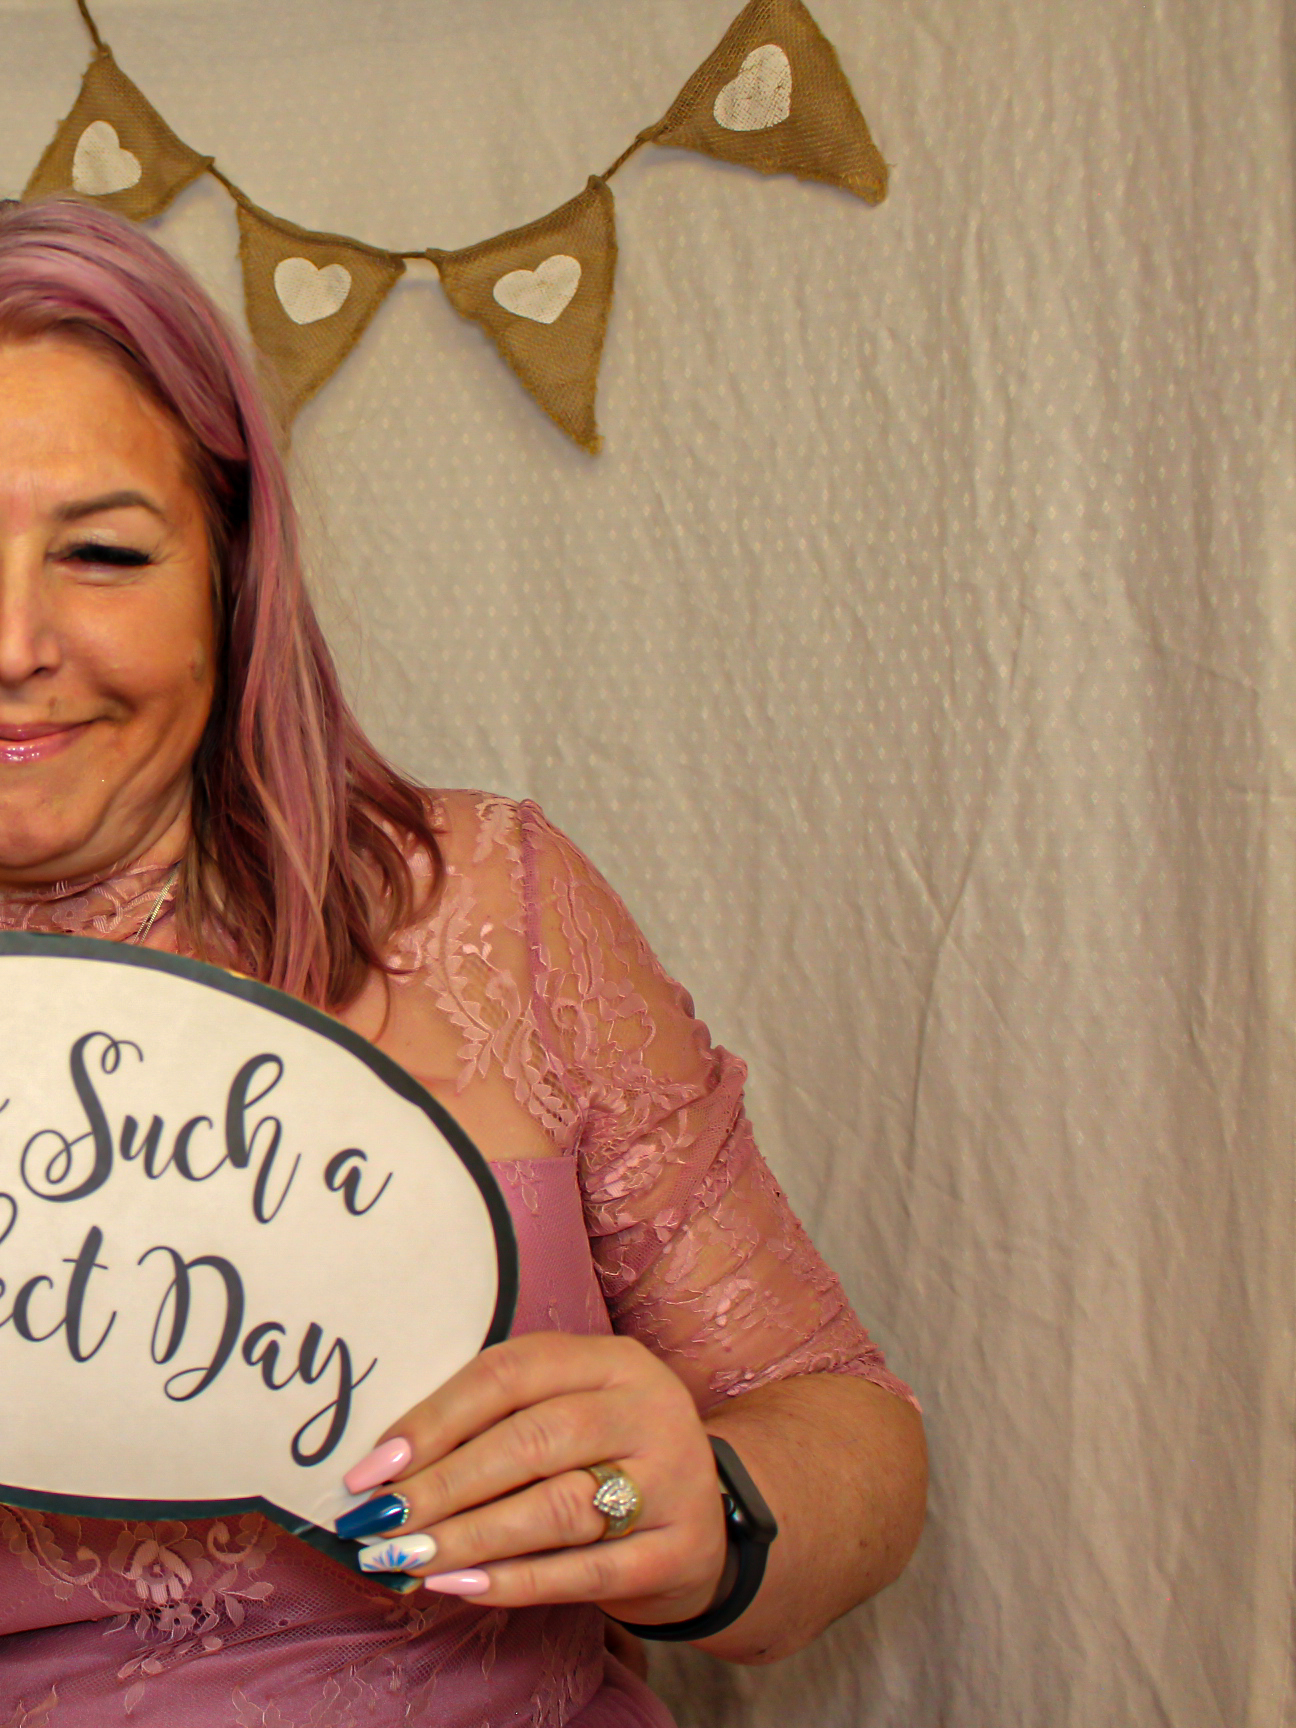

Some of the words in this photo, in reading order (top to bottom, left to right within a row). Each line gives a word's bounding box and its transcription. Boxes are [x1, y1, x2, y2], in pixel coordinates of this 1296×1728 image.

[20, 1031, 301, 1224] Such
[323, 1147, 393, 1217] a
[137, 1245, 378, 1468] Day
